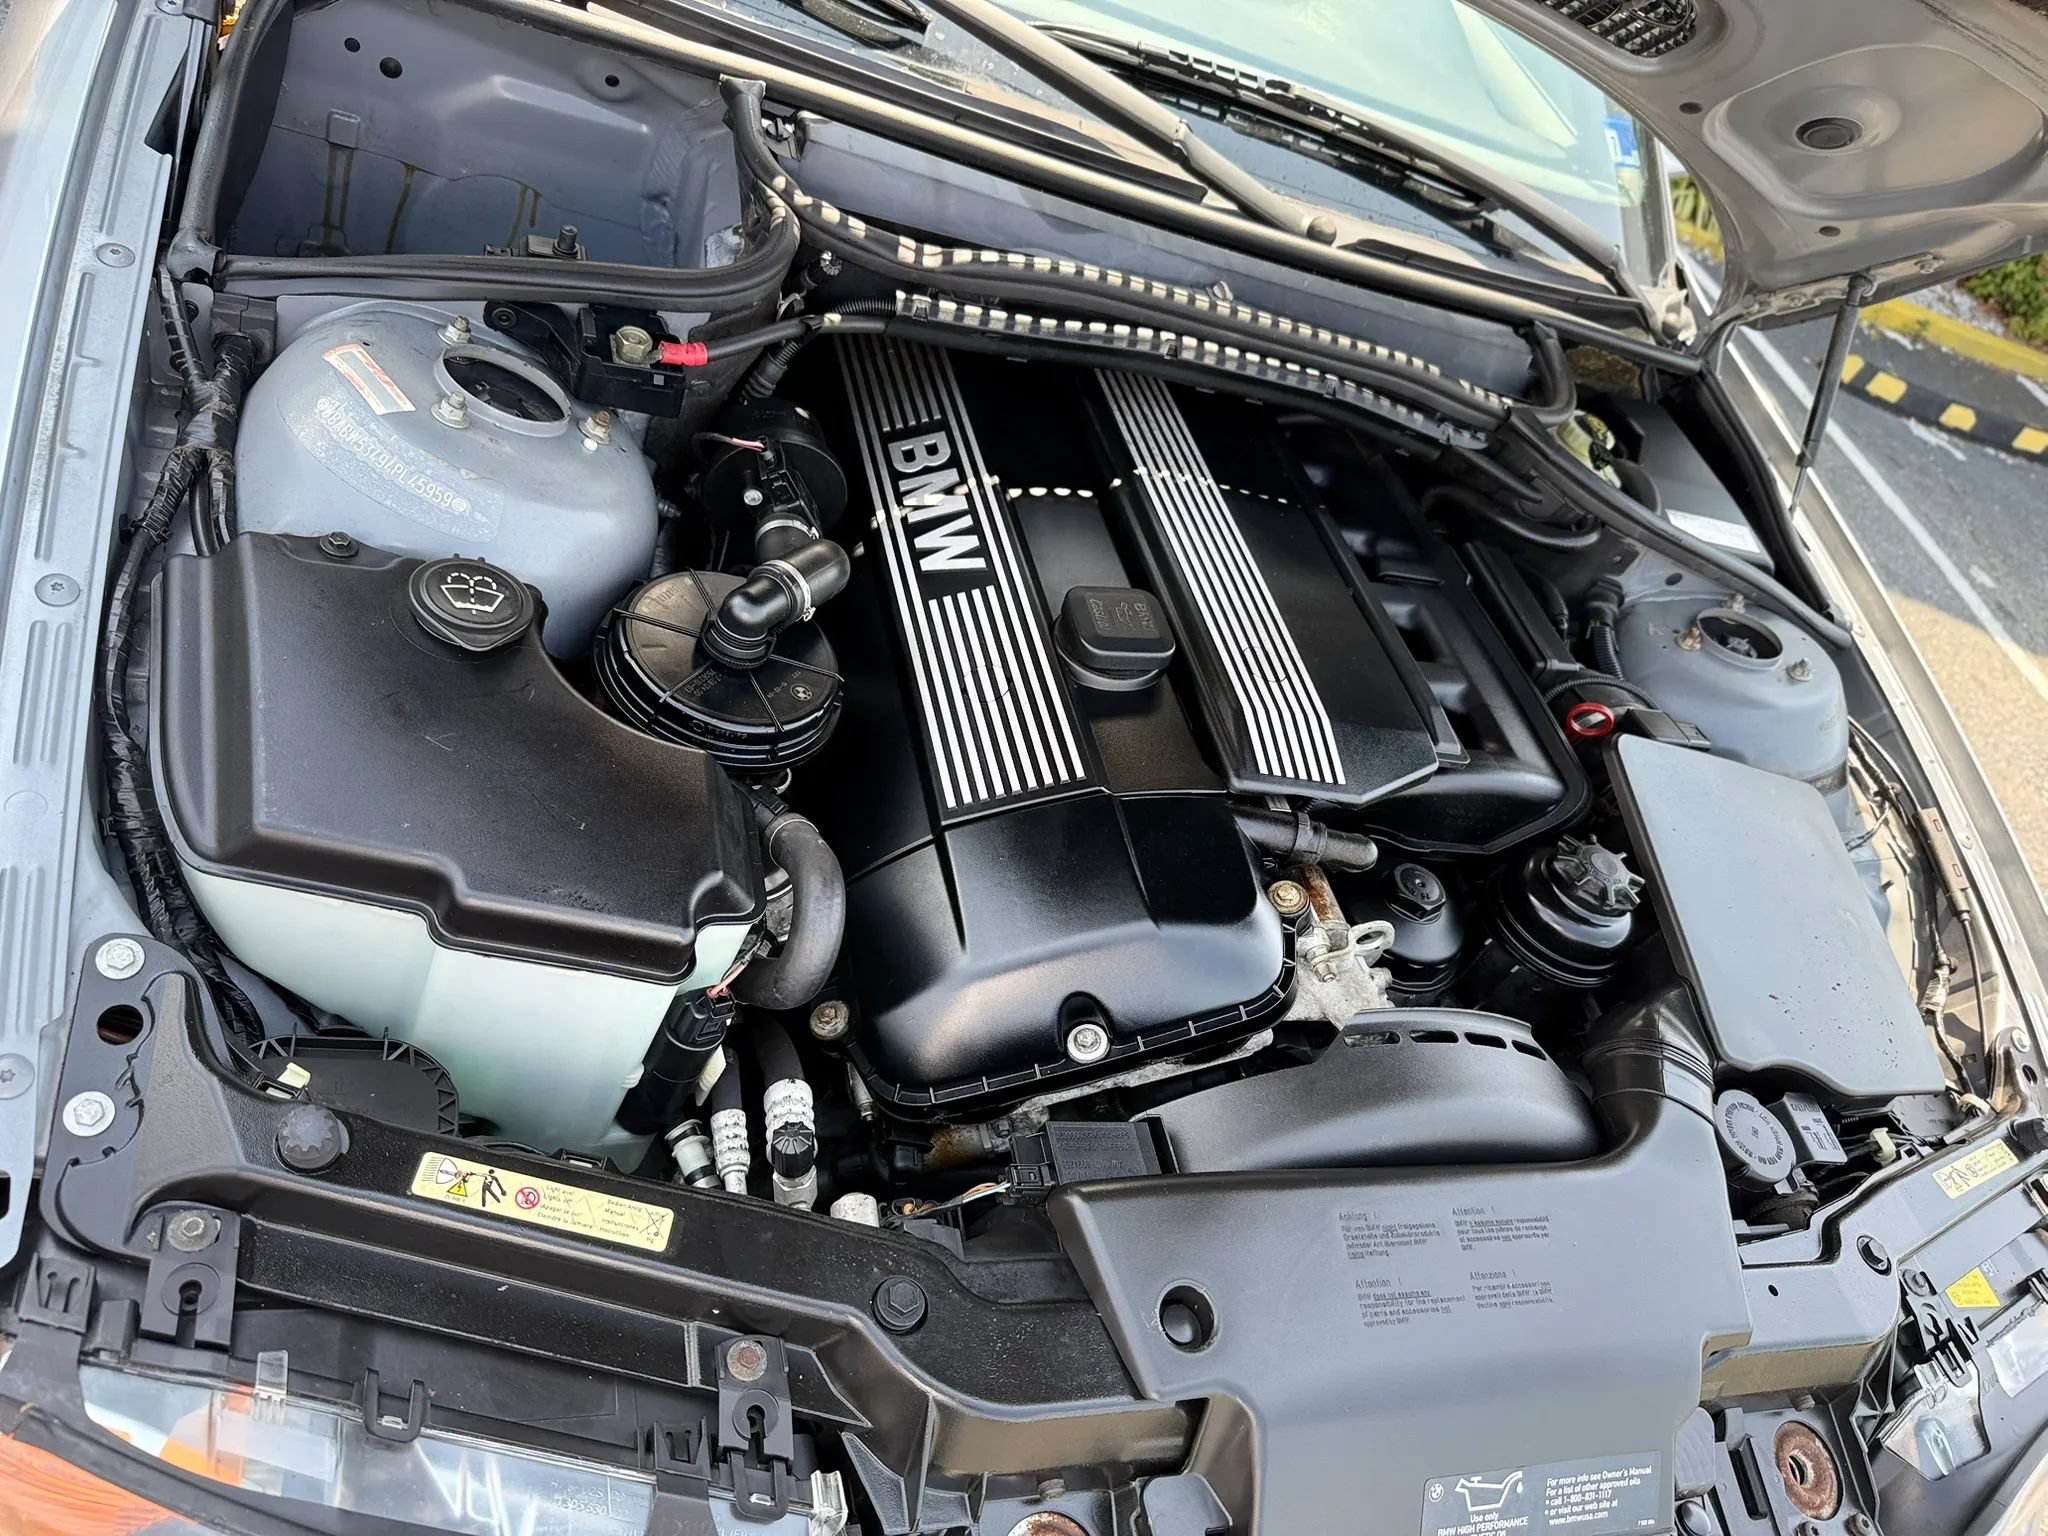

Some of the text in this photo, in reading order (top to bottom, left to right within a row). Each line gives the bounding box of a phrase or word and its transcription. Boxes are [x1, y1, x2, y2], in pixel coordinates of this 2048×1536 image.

[888, 431, 987, 571] BMW
[1452, 1207, 1486, 1216] Attention
[1355, 1279, 1391, 1289] Attention
[1547, 1465, 1651, 1487] For more info see Owner's Manual
[1546, 1487, 1557, 1496] For
[1564, 1485, 1574, 1494] list
[1582, 1483, 1599, 1492] other
[1599, 1479, 1628, 1491] approved
[1629, 1477, 1641, 1485] oils
[1550, 1497, 1562, 1506] call
[1559, 1506, 1571, 1515] visit
[1572, 1504, 1583, 1512] our
[1584, 1502, 1598, 1511] web
[1599, 1500, 1610, 1509] site
[1470, 1512, 1499, 1523] Use only
[1549, 1511, 1608, 1526] www.bmwusa.com
[1438, 1526, 1457, 1536] BMW
[1457, 1524, 1475, 1535] HIGH
[1477, 1516, 1528, 1533] PERFORMANCE
